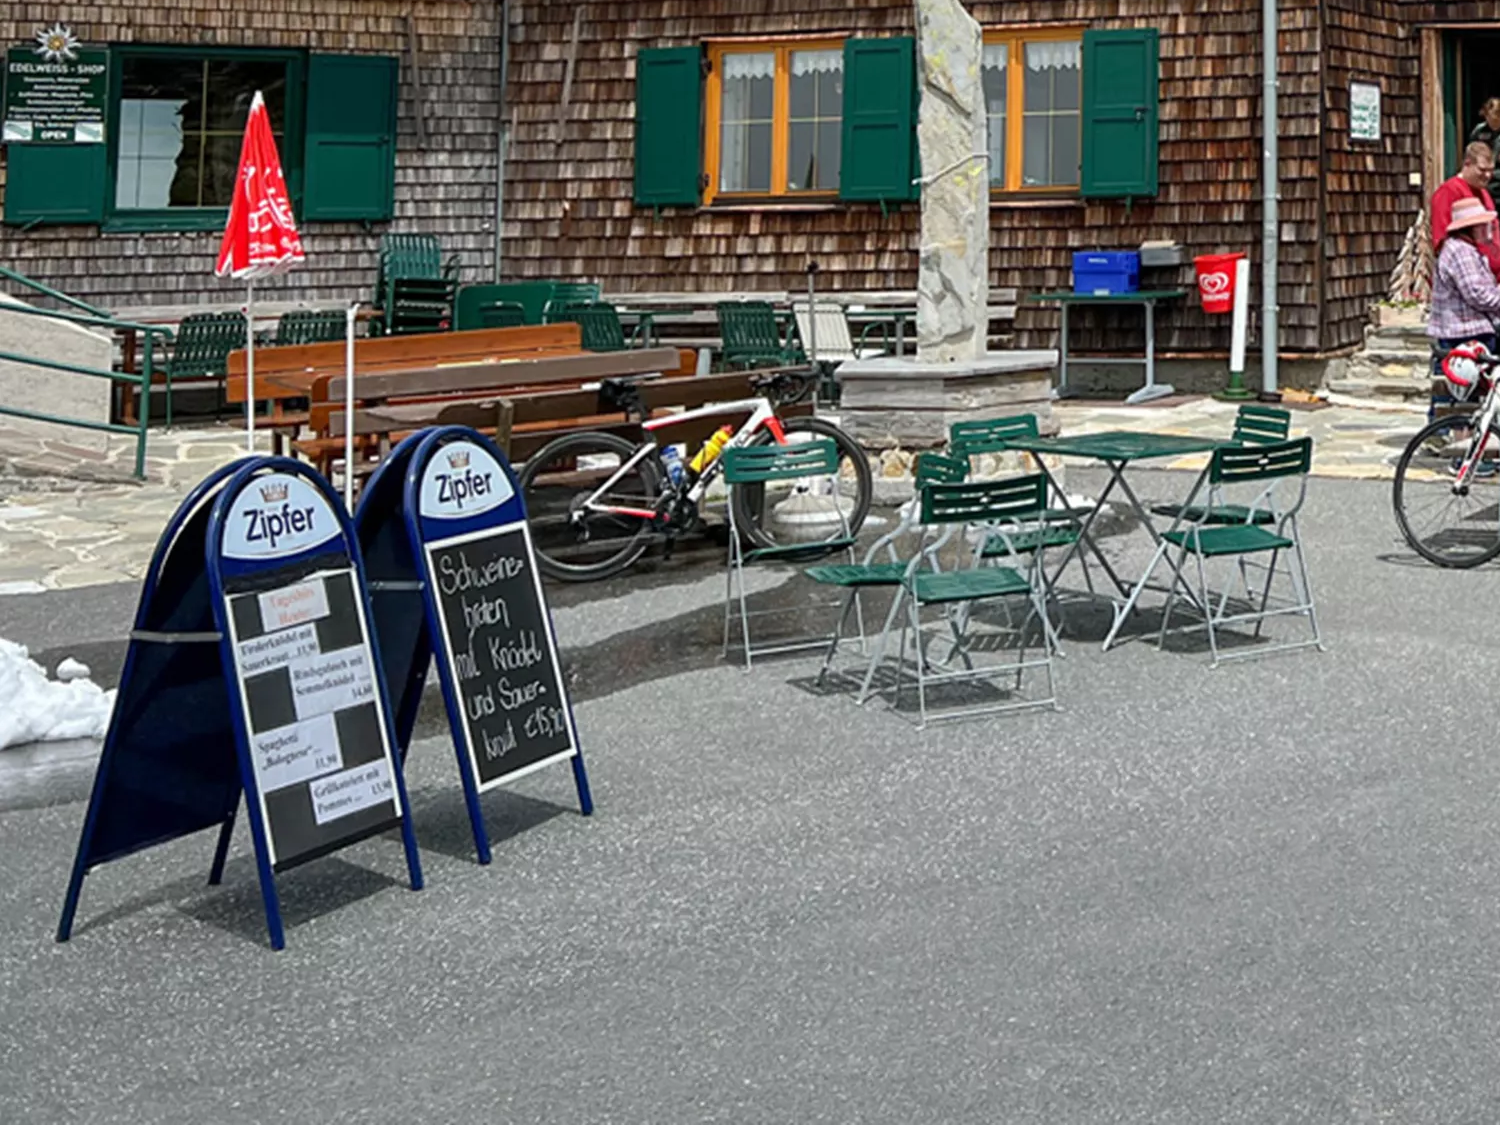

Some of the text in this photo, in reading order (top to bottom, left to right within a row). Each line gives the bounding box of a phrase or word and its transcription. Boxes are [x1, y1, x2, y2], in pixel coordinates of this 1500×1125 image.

[9, 62, 68, 73] EDELWEISS
[77, 64, 105, 74] SHOP
[41, 130, 67, 140] OPEN
[435, 469, 491, 509] Zipfer
[243, 503, 314, 548] Zipfer
[467, 684, 495, 721] und
